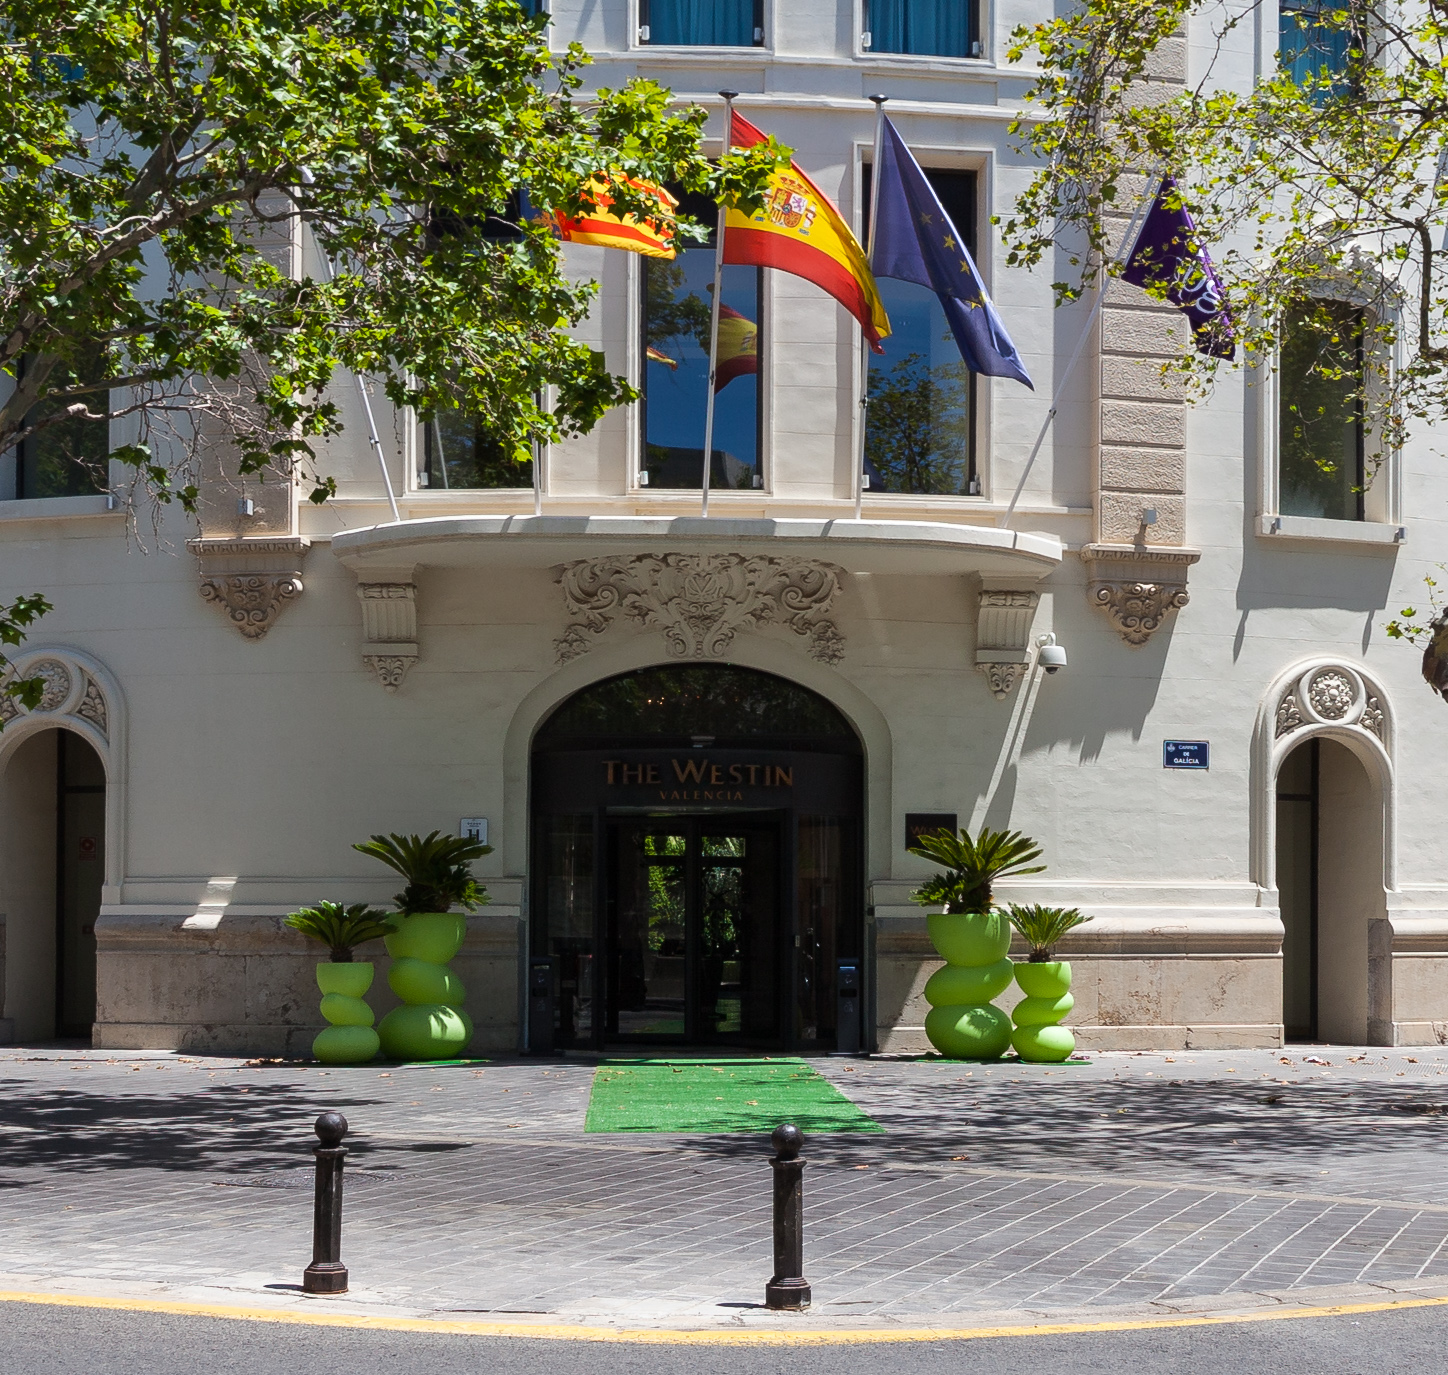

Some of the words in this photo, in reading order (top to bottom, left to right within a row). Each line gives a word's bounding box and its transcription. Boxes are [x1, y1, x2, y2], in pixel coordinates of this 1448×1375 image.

[601, 760, 662, 785] THE
[672, 759, 792, 786] WESTIN
[660, 790, 743, 801] VALENCIA
